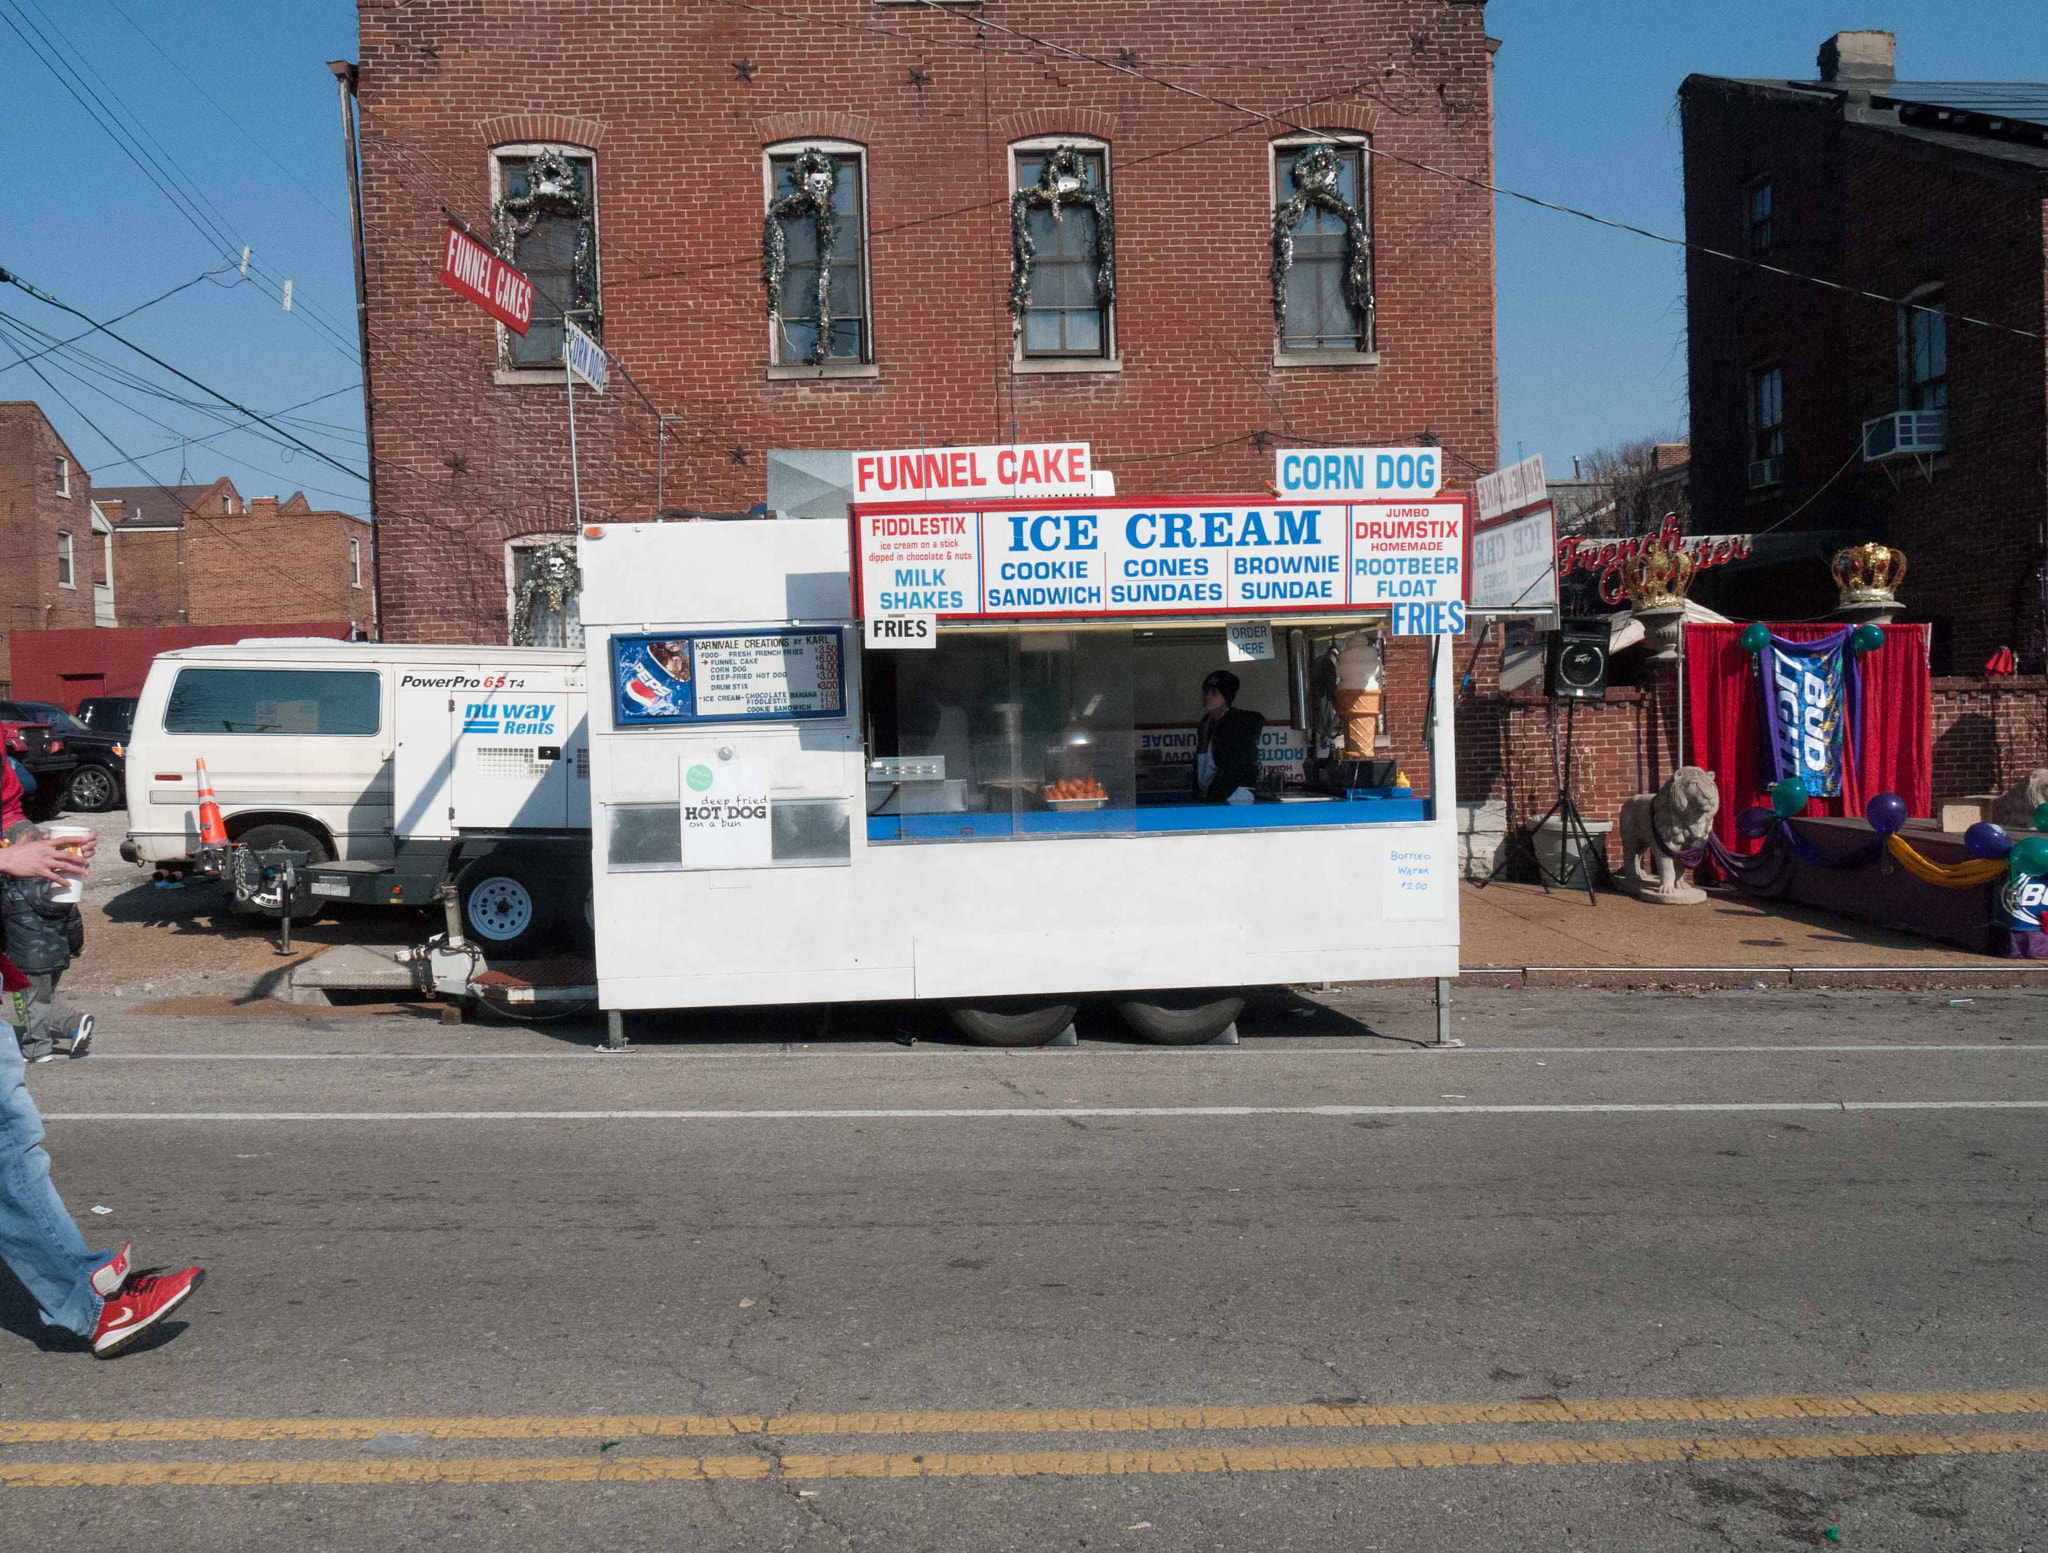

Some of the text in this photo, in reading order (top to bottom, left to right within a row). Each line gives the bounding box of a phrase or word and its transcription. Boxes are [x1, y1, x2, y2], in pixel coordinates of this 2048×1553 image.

[446, 230, 532, 323] FUNNEL CAKES
[857, 448, 1086, 493] FUNNEL CAKE
[1283, 453, 1434, 490] CORN DOG
[1386, 508, 1429, 518] JUMBO
[872, 516, 966, 536] FIDDLESTIX
[1008, 510, 1321, 552] ICE CREAM
[1355, 520, 1458, 539] DRUMSTIX
[880, 541, 891, 550] ice
[894, 541, 918, 550] cream
[921, 541, 930, 549] on
[940, 539, 958, 548] stick
[1371, 541, 1443, 552] HOMEMADE
[1557, 511, 1686, 577] French
[869, 552, 894, 563] dipped
[897, 551, 903, 561] in
[906, 551, 943, 561] chocolate
[955, 551, 972, 560] nuts
[1234, 555, 1340, 575] BROWNIE
[1355, 557, 1458, 576] ROOTBEER
[895, 568, 946, 587] MILK
[1001, 560, 1088, 581] COOKIE
[1124, 558, 1209, 578] CONES
[988, 586, 1101, 607] SANDWICH
[1111, 583, 1222, 602] SUNDAES
[1241, 580, 1332, 600] SUNDAE
[1377, 579, 1437, 598] FLOAT
[880, 591, 963, 610] SHAKES
[1392, 600, 1465, 635] FRIES
[873, 619, 927, 638] FRIES
[1232, 626, 1267, 639] ORDER
[695, 640, 739, 650] KARNIVALE
[744, 638, 789, 649] CREATIONS
[806, 636, 829, 645] KARL
[1238, 642, 1265, 655] HERE
[400, 675, 525, 688] PowerPro 65 T4
[465, 704, 555, 721] nu way
[1804, 672, 1827, 771] BUD
[504, 721, 555, 735] Rents
[1142, 734, 1197, 748] UNDAE
[701, 794, 768, 809] deep fried
[685, 805, 766, 820] HOT DOG
[721, 818, 741, 828] bun
